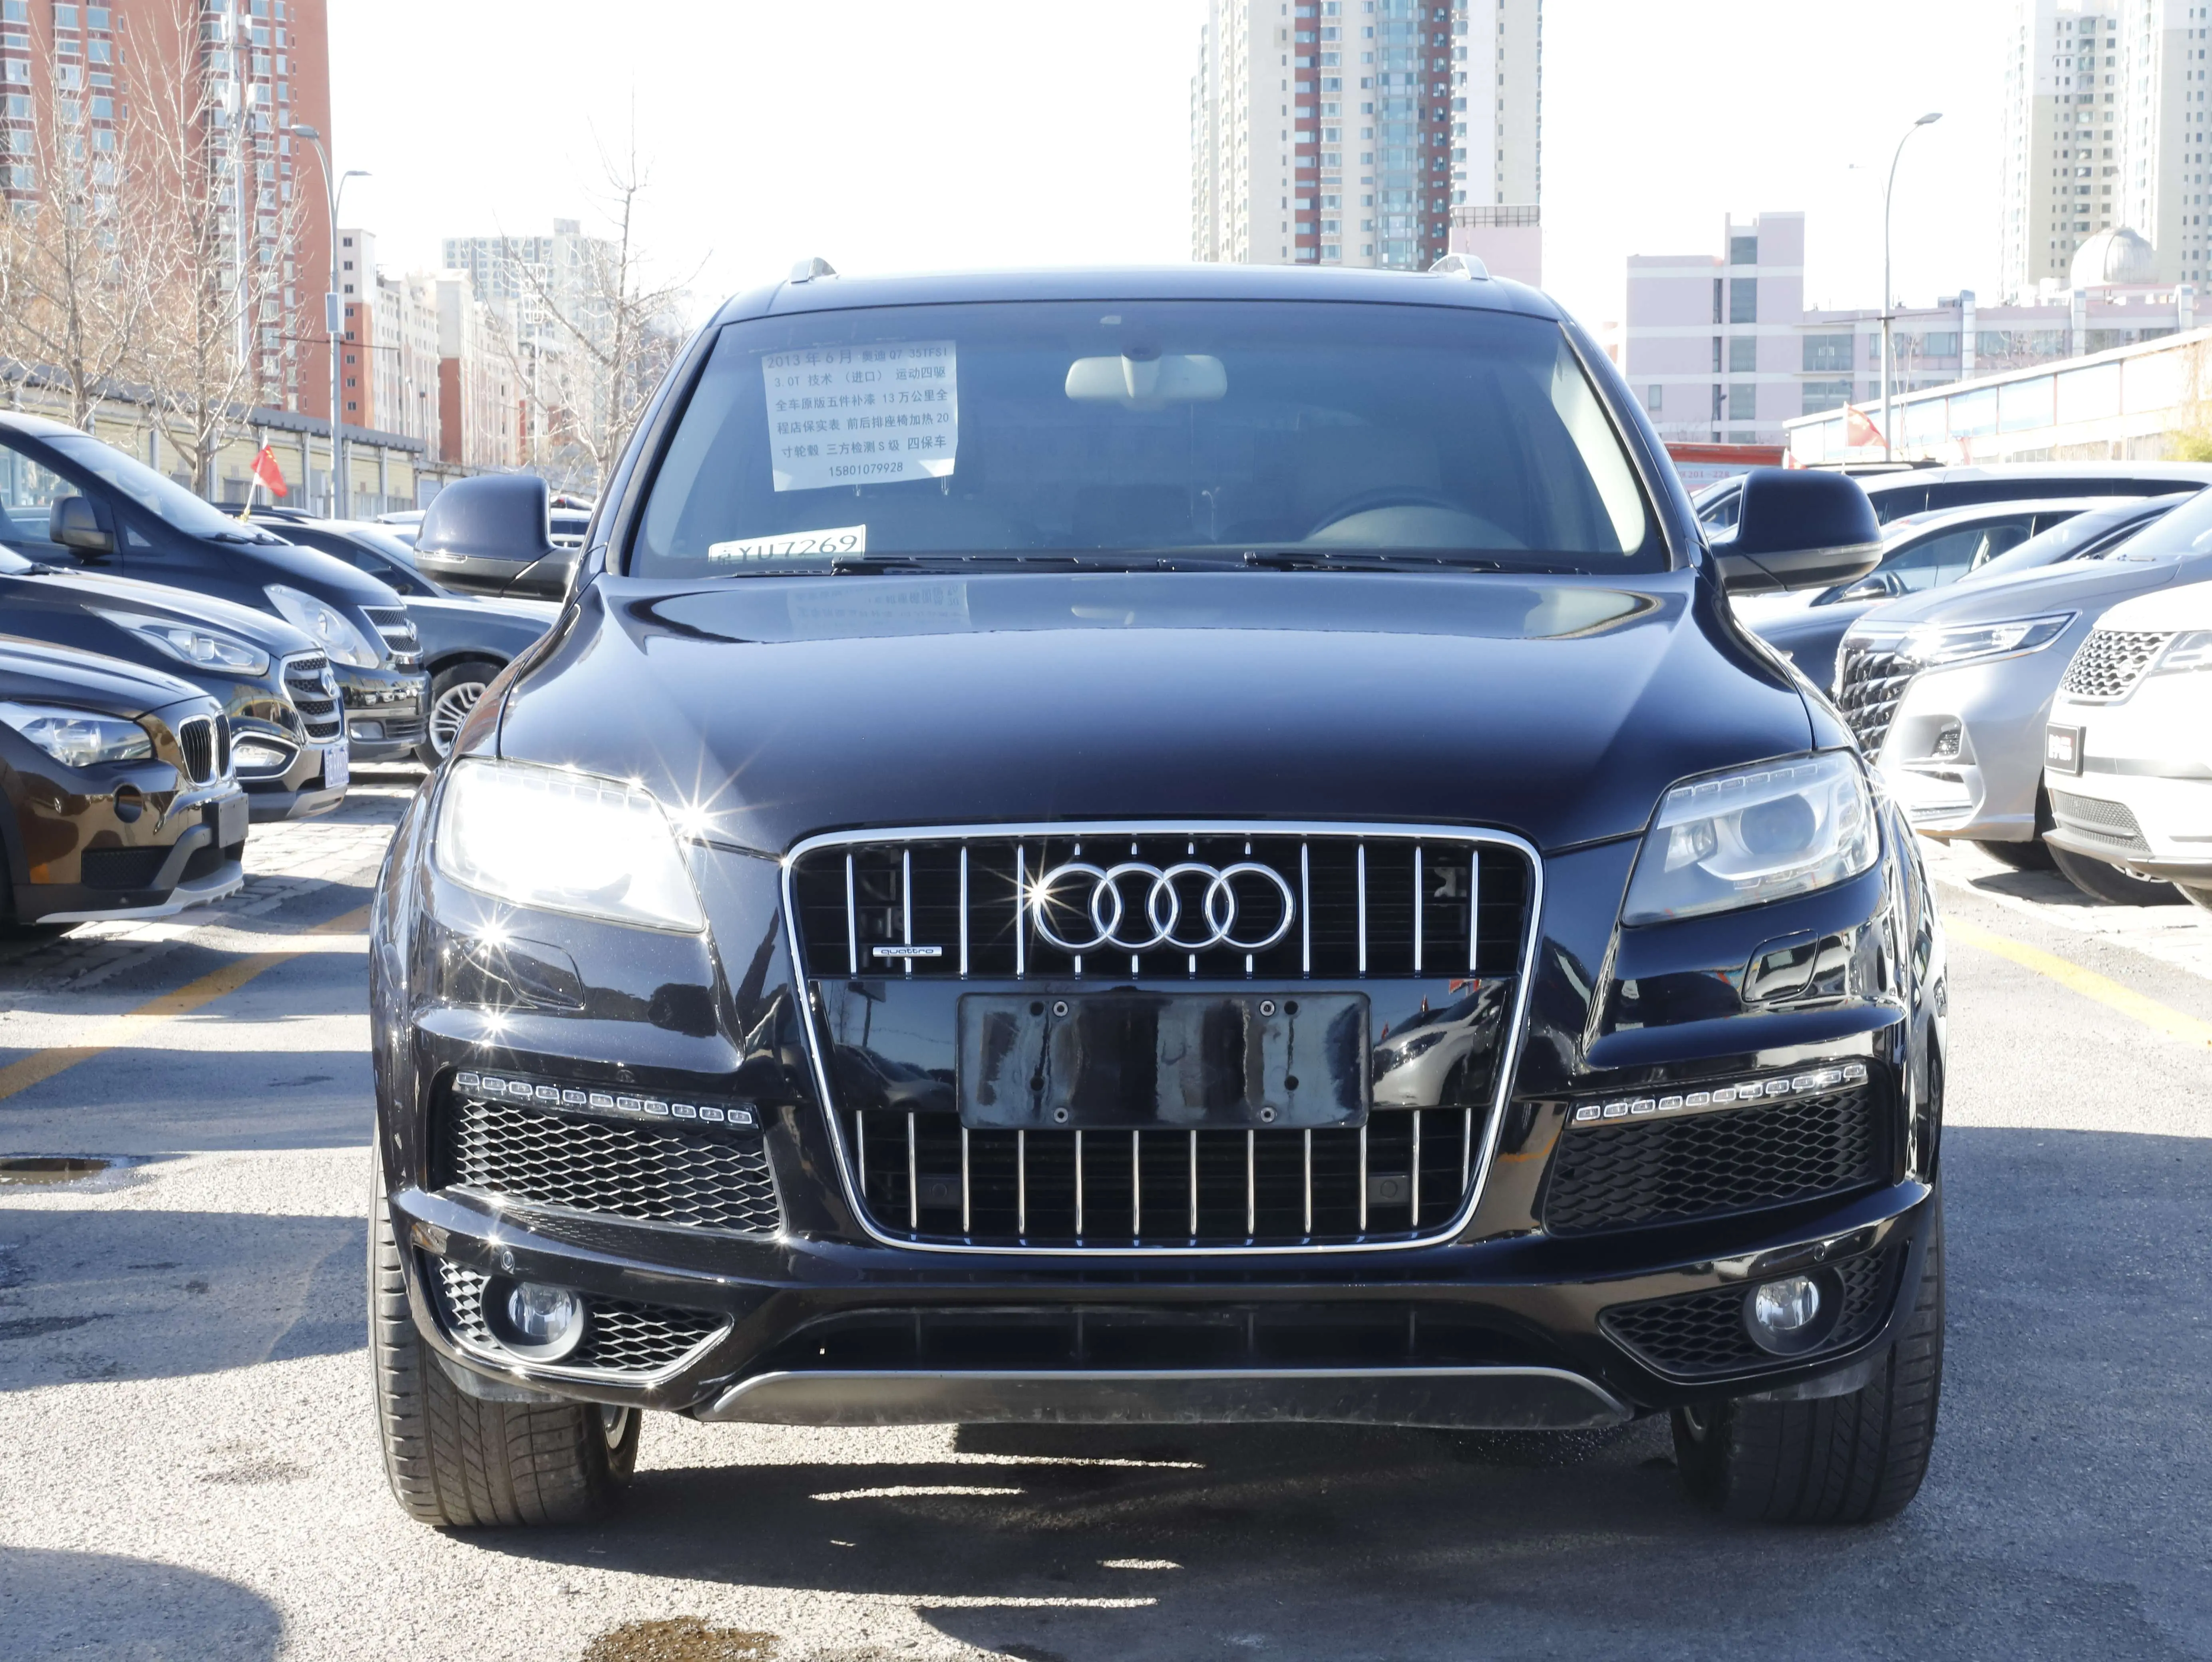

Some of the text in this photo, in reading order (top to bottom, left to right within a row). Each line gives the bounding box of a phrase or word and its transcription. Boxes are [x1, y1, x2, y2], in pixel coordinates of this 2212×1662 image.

[767, 354, 800, 369] 2013
[909, 347, 947, 358] 35TFSI
[808, 372, 833, 387] 技术
[895, 366, 946, 380] 运动四驱
[775, 393, 875, 412] 全车原版五件补漆
[777, 418, 841, 435] 程店保实表
[907, 434, 947, 450] 四保车
[829, 461, 903, 477] 15801079928
